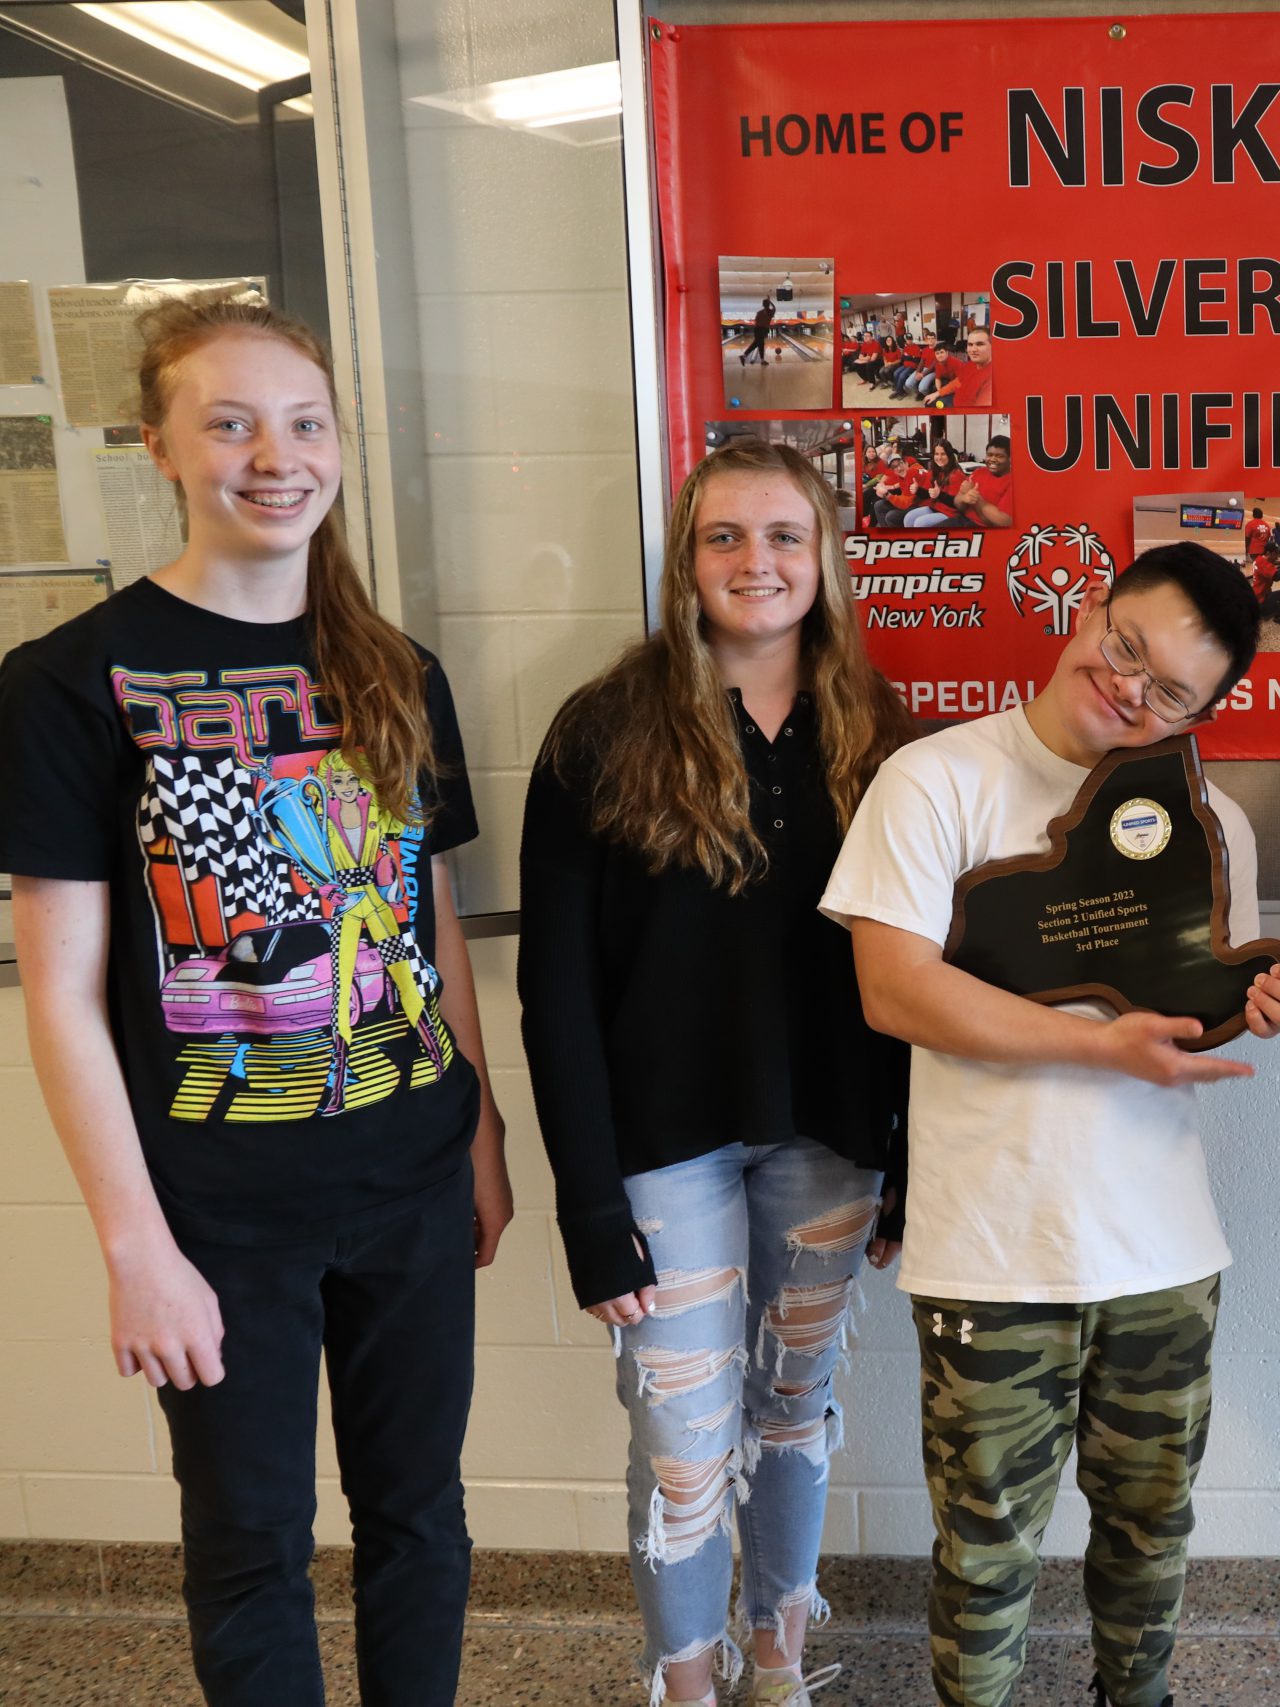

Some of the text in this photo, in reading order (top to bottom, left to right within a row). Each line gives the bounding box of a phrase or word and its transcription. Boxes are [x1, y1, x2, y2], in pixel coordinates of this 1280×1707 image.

[740, 111, 964, 158] HOME OF
[95, 452, 149, 463] School ho
[844, 532, 985, 565] Special
[851, 566, 986, 600] ympics
[867, 601, 987, 630] New York
[1045, 889, 1135, 915] Spring Season 2023
[1037, 903, 1148, 930] Section 2 Unified Sports
[1041, 917, 1149, 944] Basketball Tournament
[1076, 938, 1120, 952] 3rd Place
